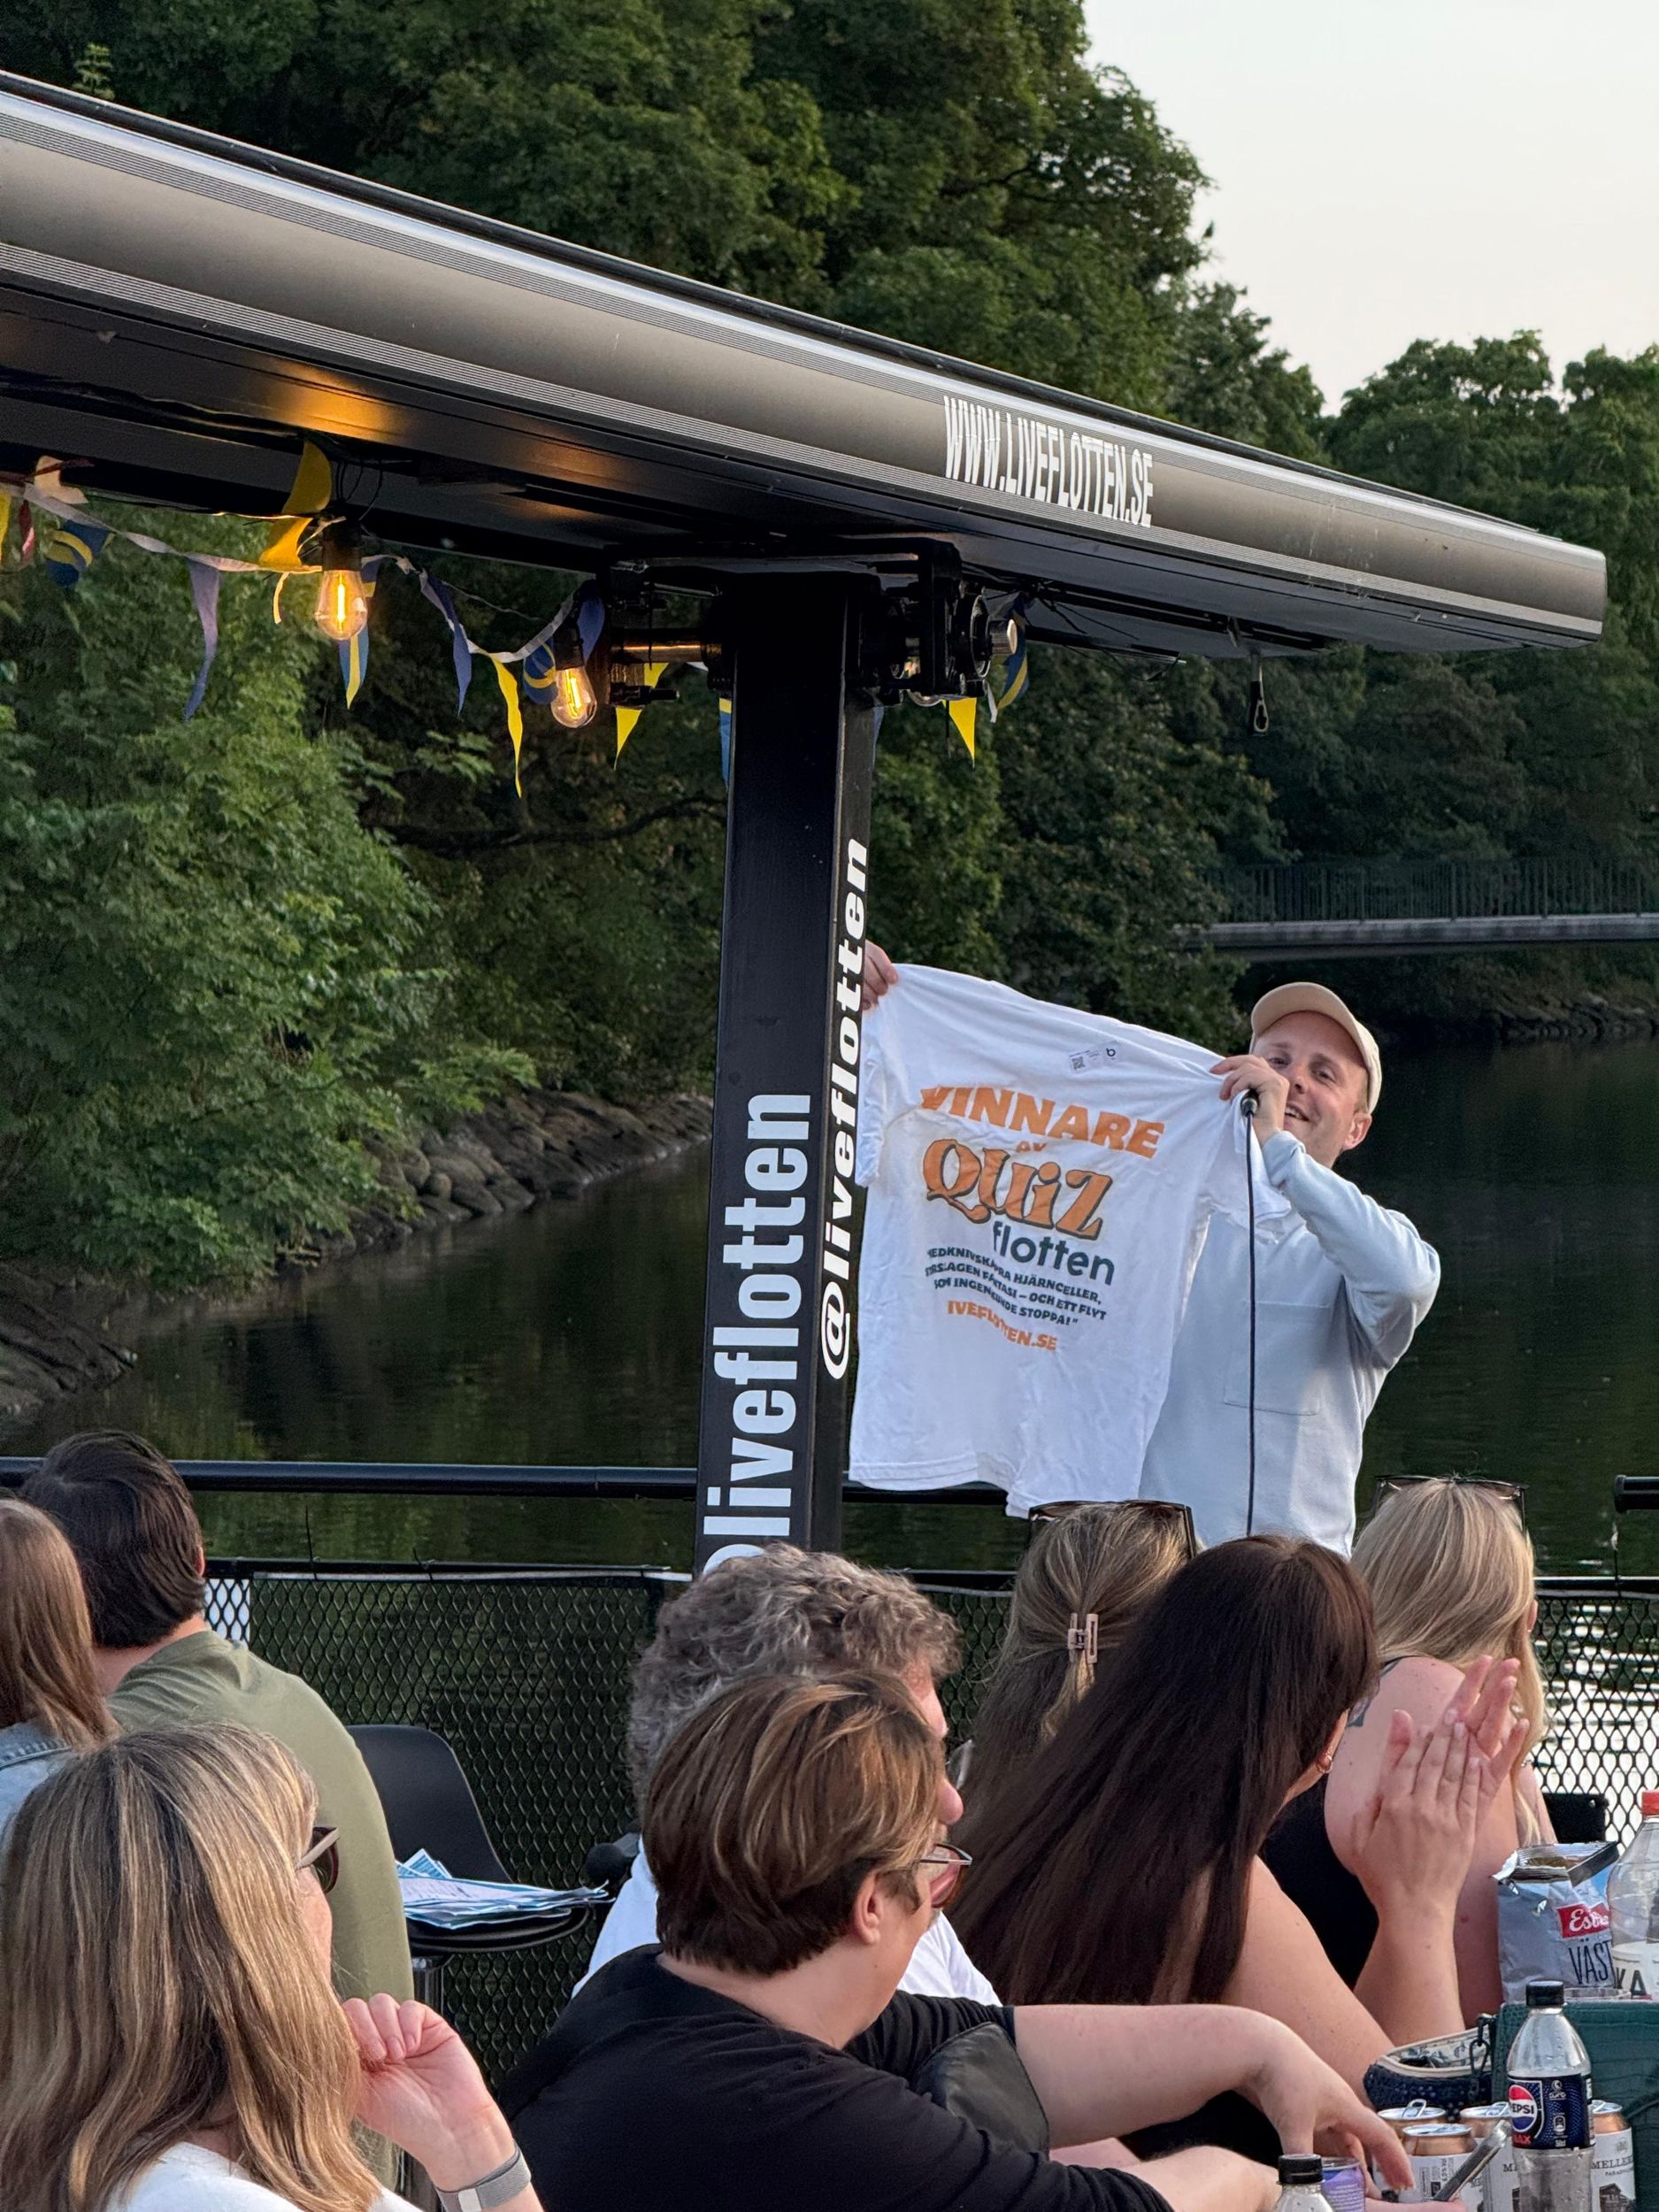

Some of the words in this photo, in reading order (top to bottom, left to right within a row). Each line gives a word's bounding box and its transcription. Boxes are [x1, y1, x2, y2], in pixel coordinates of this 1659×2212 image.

[943, 396, 1154, 529] WWW.LIVEFLOTTEN.SE
[821, 838, 868, 1380] @liveflotten
[920, 1086, 1165, 1158] VINNARE
[993, 1221, 1115, 1286] flotten
[953, 1278, 992, 1295] INGEN
[1014, 1271, 1102, 1305] HJÄRNCELLER,
[1029, 1292, 1056, 1306] OCH
[1056, 1301, 1079, 1313] ETT
[1078, 1305, 1108, 1321] FLYT
[1511, 2102, 1534, 2115] EPSI
